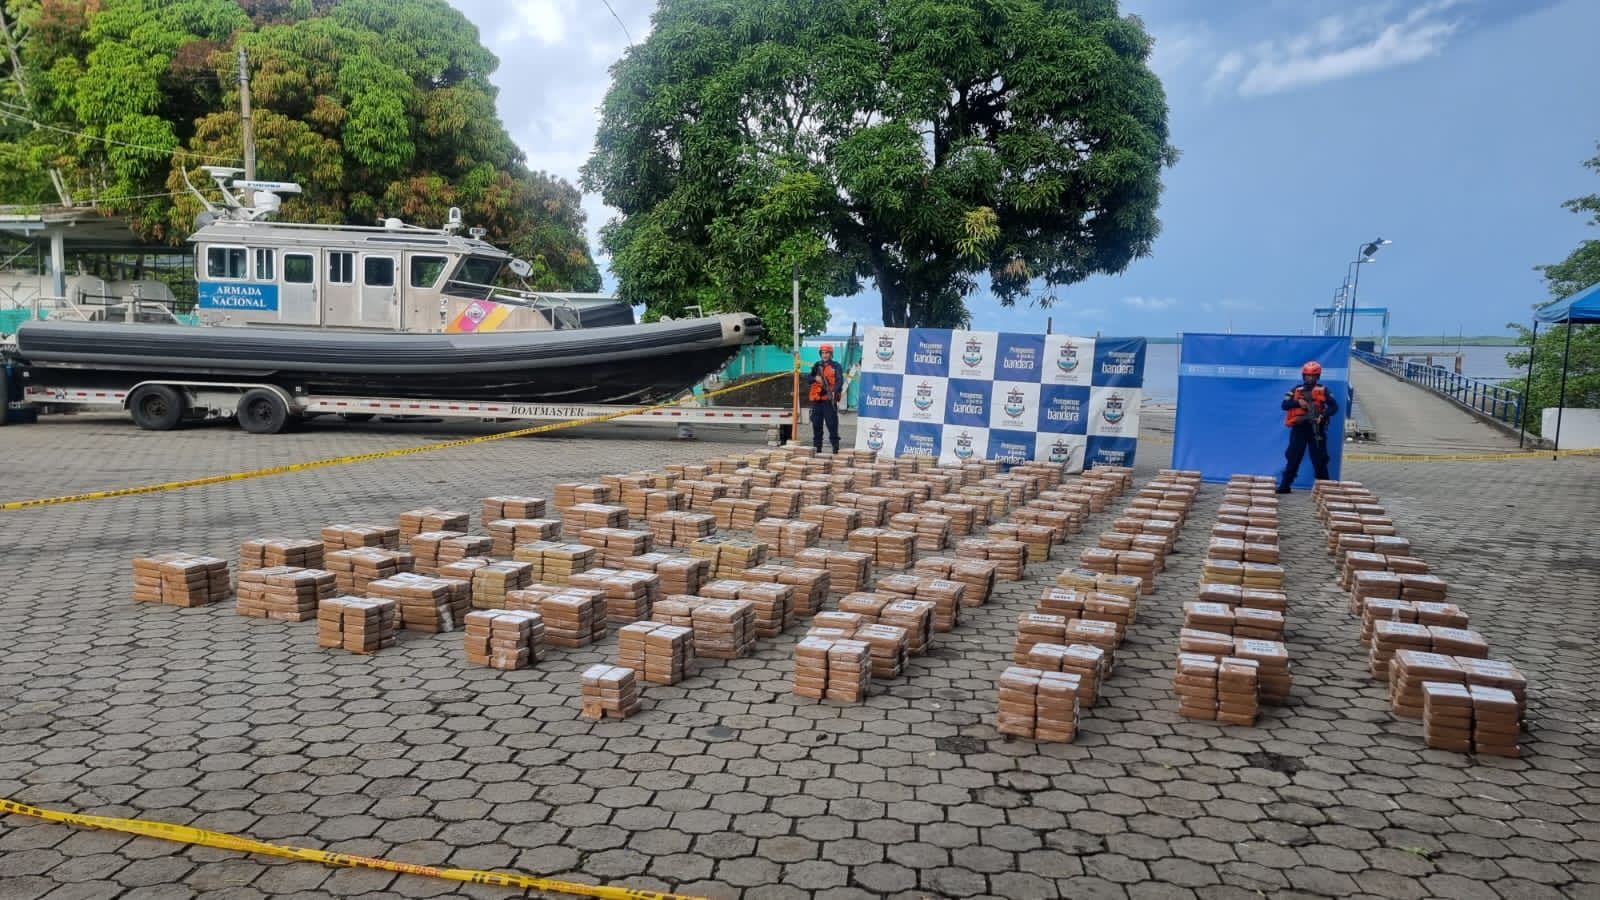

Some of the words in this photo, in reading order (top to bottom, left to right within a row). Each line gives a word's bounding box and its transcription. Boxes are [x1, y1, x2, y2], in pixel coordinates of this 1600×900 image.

[216, 286, 262, 296] ARMADA
[212, 296, 265, 307] NACIONAL
[1003, 356, 1034, 369] bandera
[511, 406, 585, 417] BOATMASTER
[953, 402, 983, 415] bandera
[1047, 407, 1080, 421] bandera
